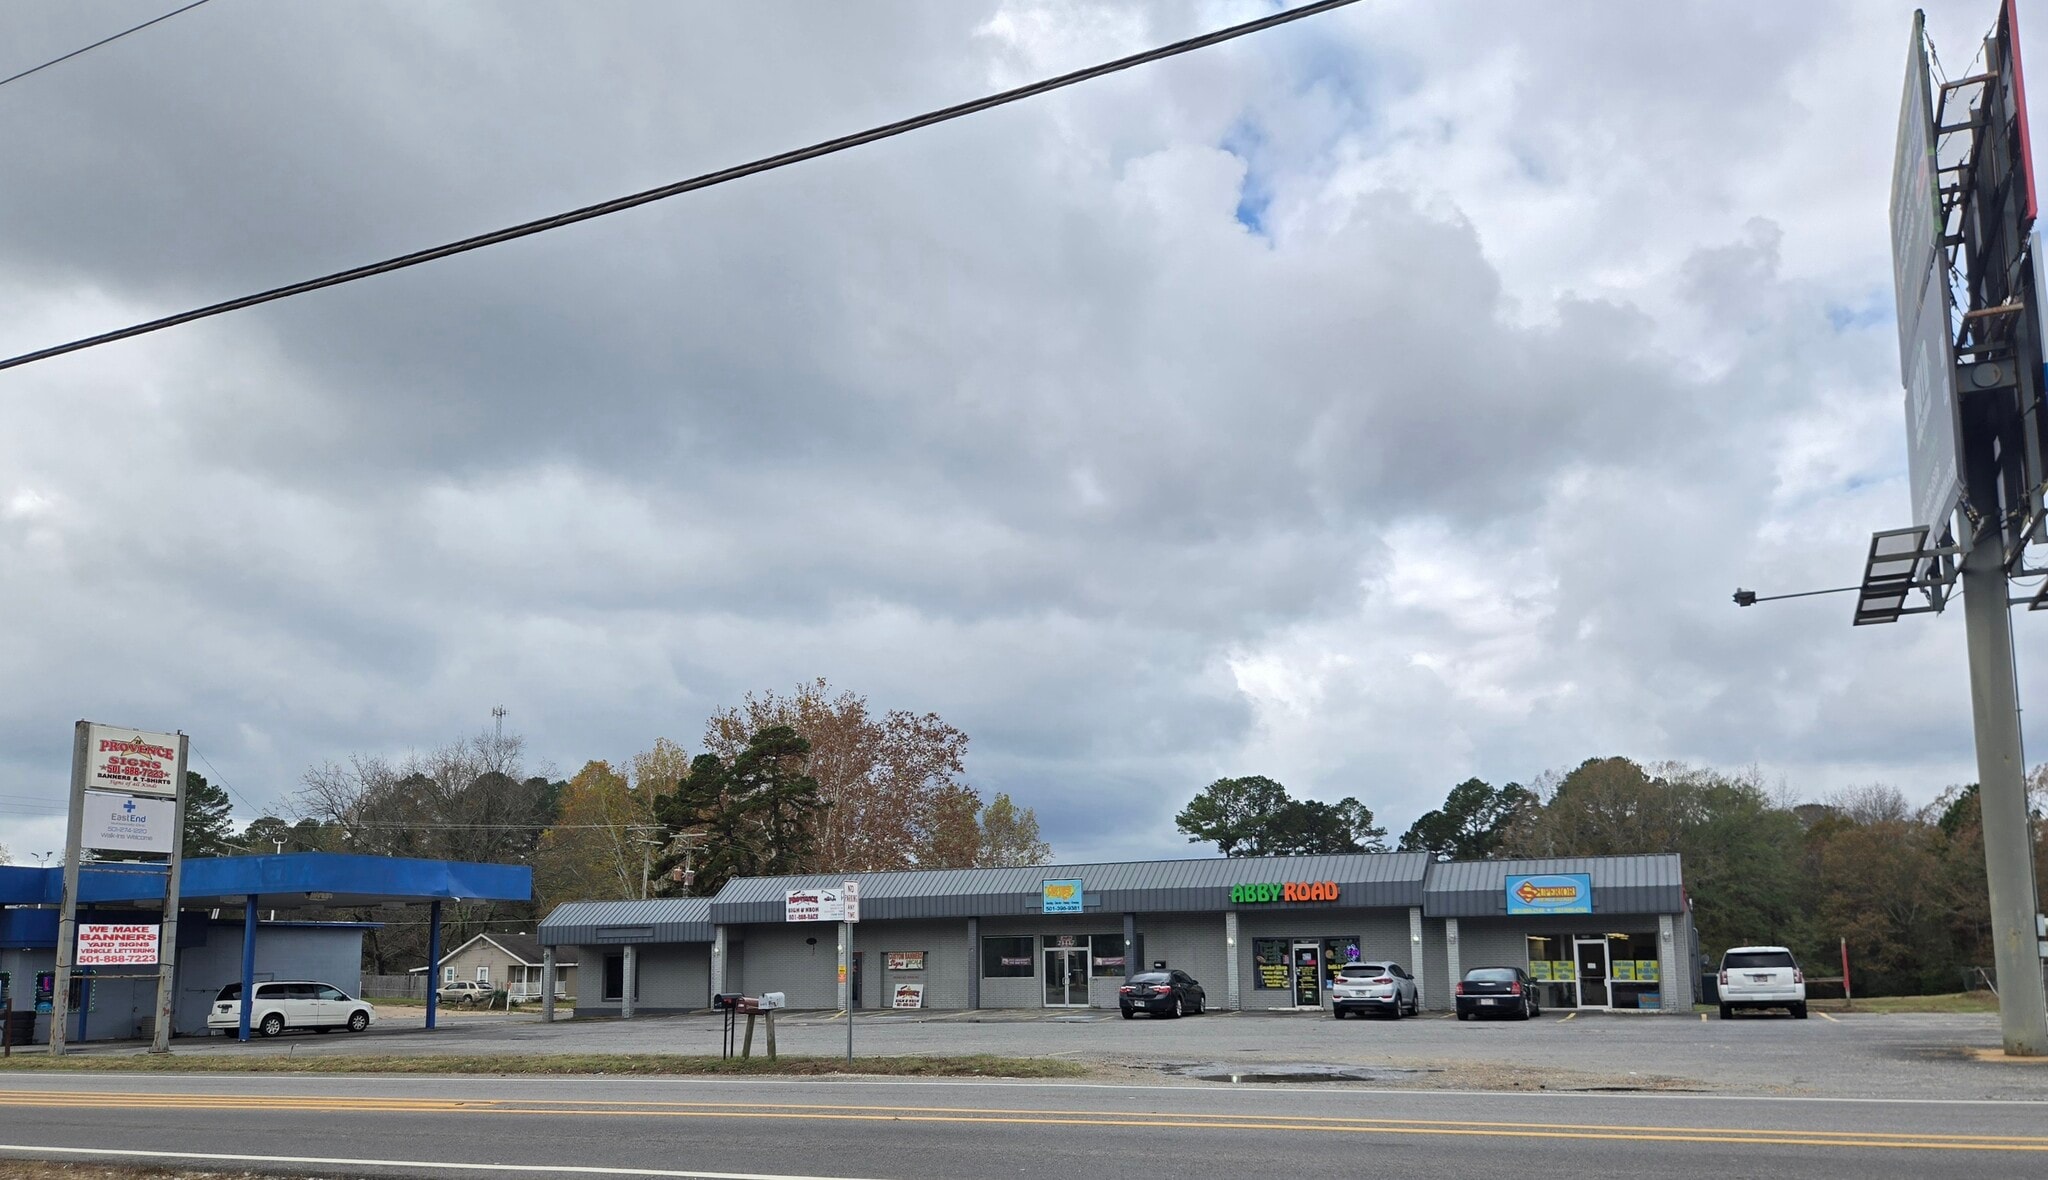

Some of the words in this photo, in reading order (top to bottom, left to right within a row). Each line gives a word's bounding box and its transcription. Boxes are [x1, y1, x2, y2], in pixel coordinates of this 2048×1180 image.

[99, 740, 174, 761] PROVENCE
[108, 756, 161, 769] SIGNS
[97, 773, 131, 781] BANNERS
[847, 885, 855, 893] NO
[1231, 882, 1282, 903] ABBY
[1284, 881, 1338, 902] ROAD
[1517, 881, 1576, 903] SUPERIOR
[79, 955, 156, 963] 501-888-7223
